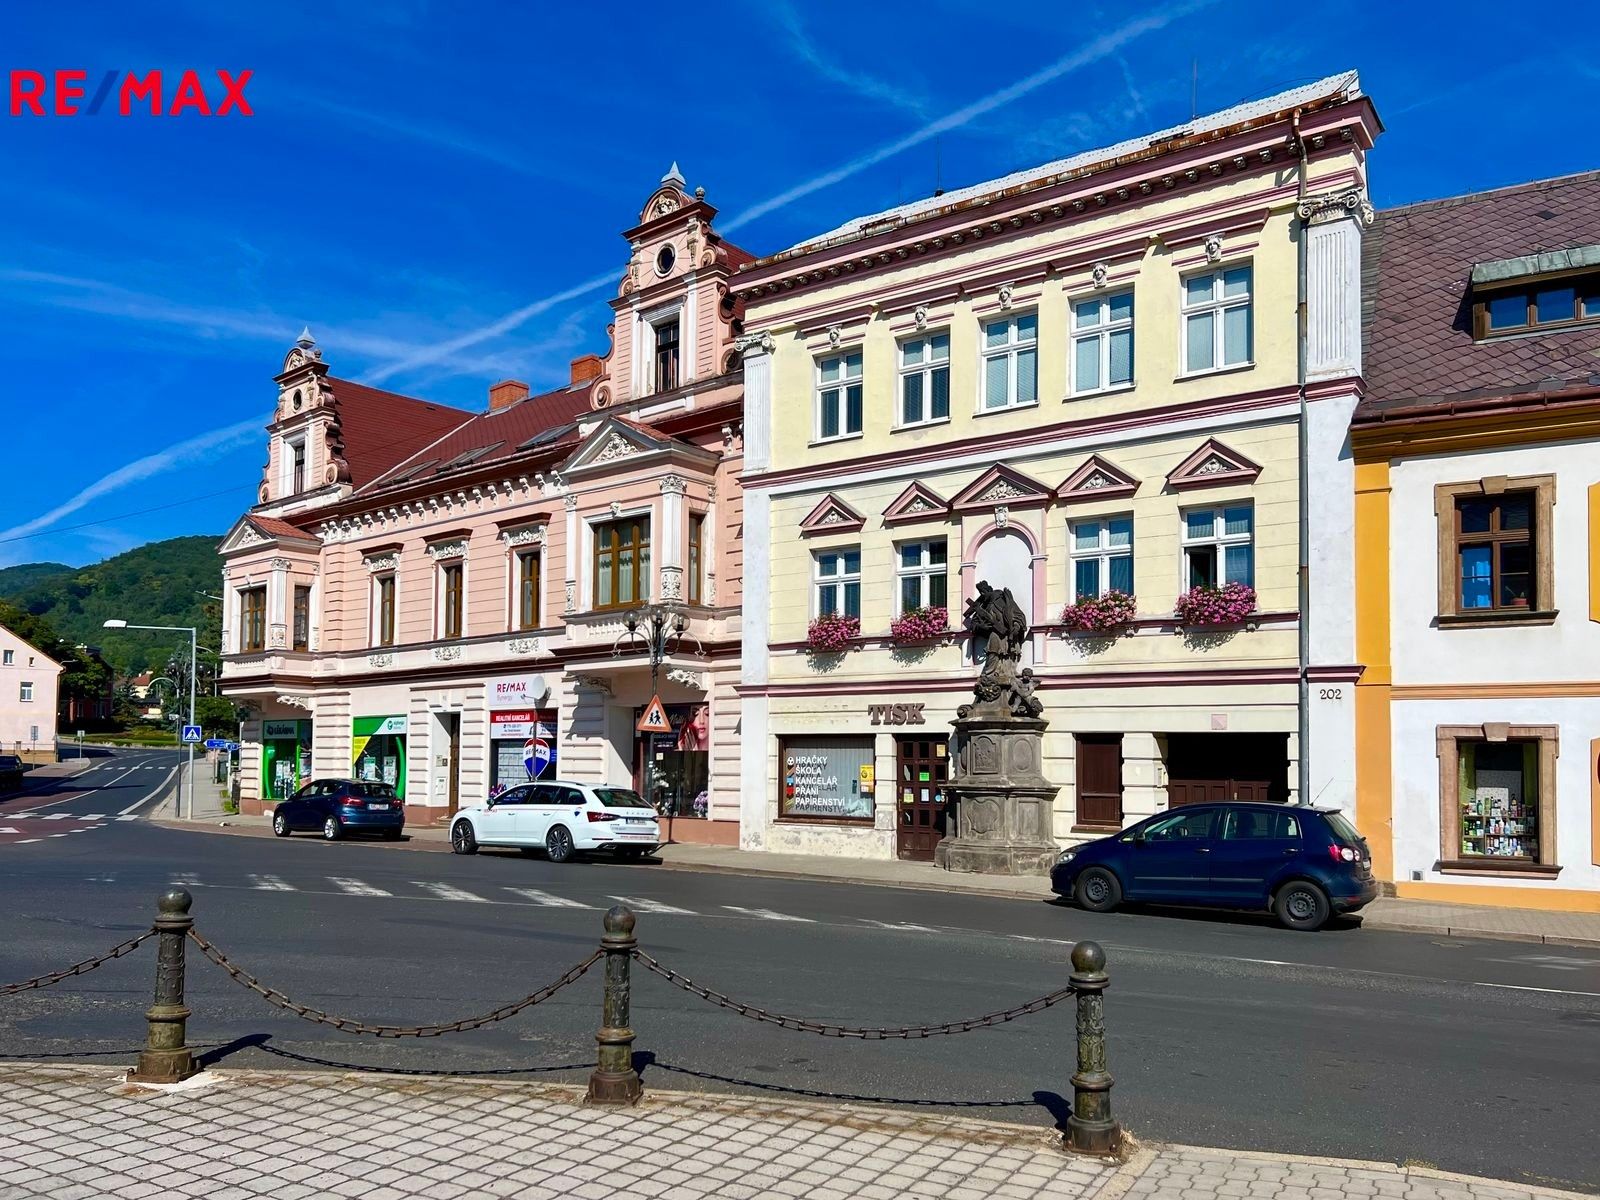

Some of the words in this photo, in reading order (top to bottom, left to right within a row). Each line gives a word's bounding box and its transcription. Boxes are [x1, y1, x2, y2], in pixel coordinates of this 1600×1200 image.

[497, 682, 526, 692] RE/MAX
[1319, 688, 1342, 700] 202
[868, 703, 926, 726] TISK
[795, 755, 828, 764] HRAČKY
[795, 765, 822, 775] ŠKOLA
[795, 776, 838, 785] KANCELÁŘ
[795, 786, 819, 795] PŘÁNÍ
[795, 797, 845, 806] PAPÍRENSTVÍ
